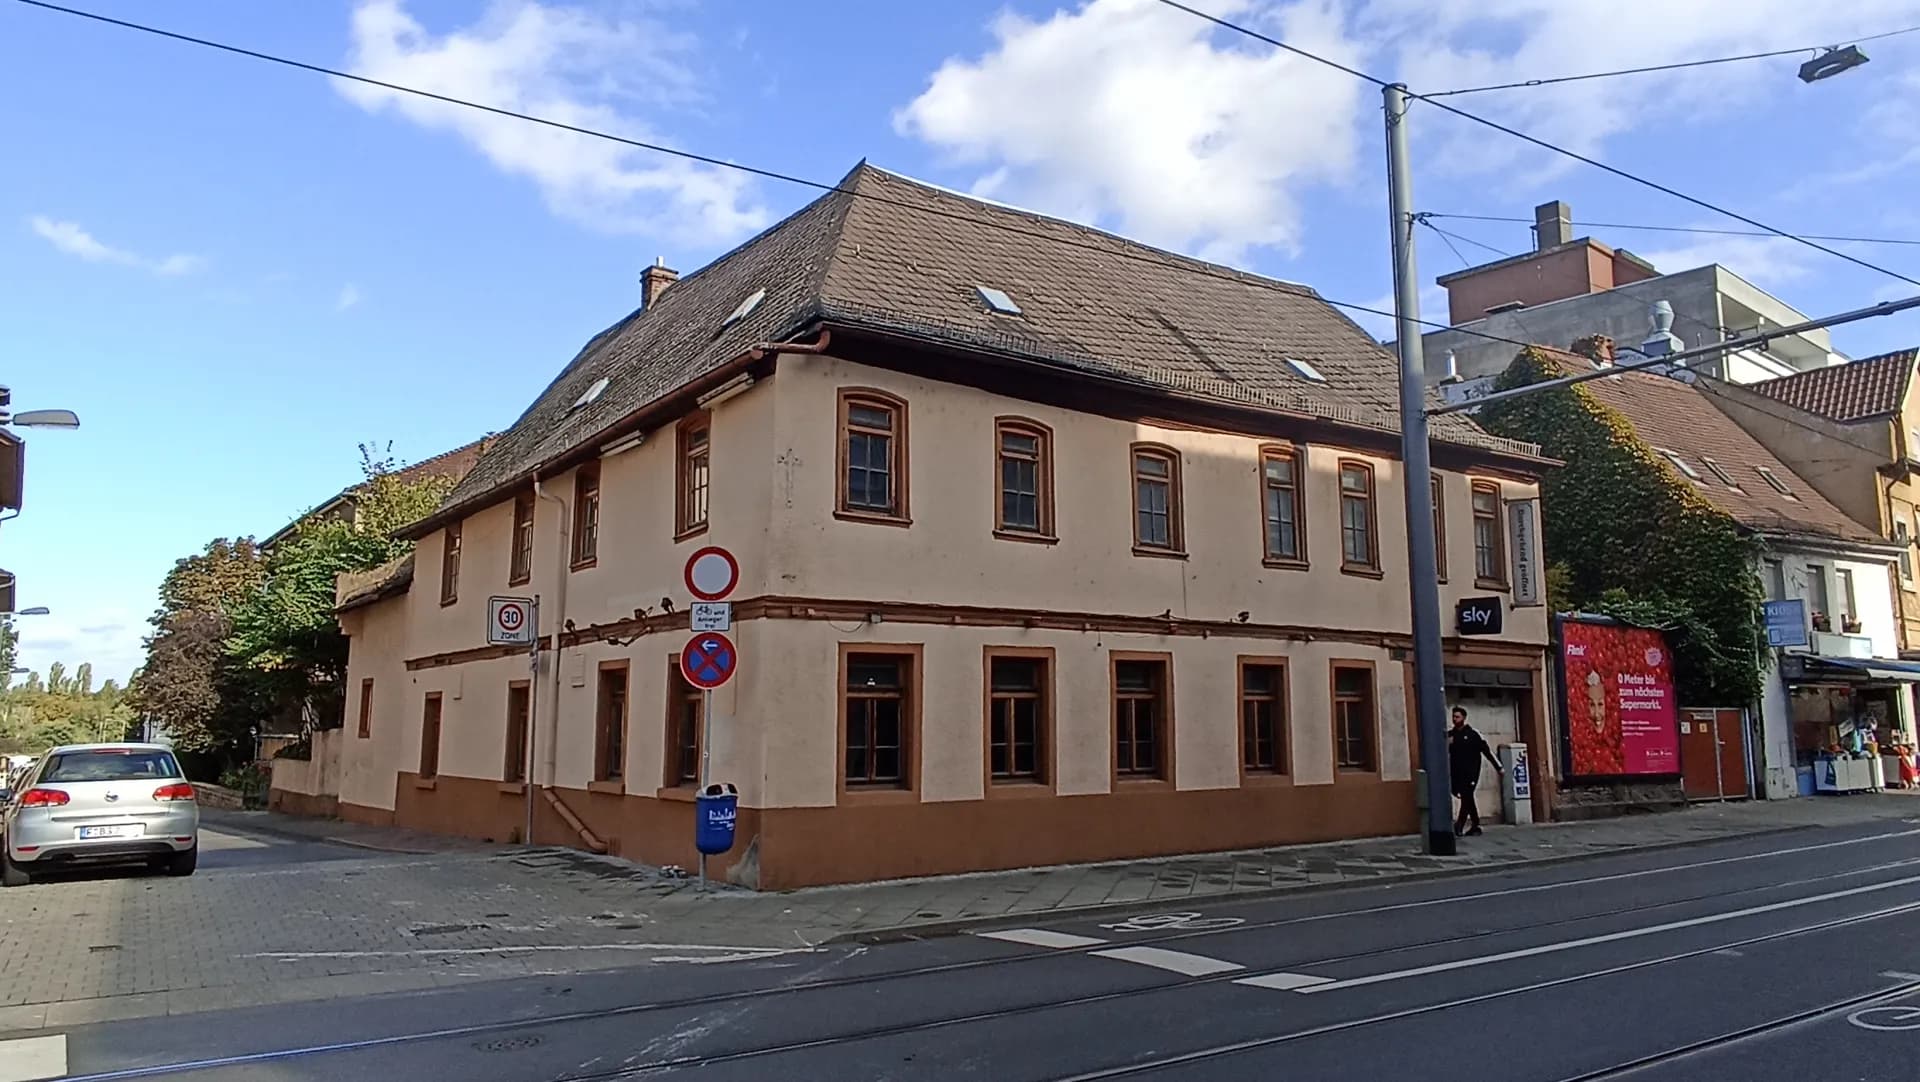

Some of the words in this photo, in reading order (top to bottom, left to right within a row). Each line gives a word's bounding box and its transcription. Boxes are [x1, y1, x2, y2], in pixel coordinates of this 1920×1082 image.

[503, 611, 519, 624] 30
[1462, 606, 1492, 626] sky
[1624, 674, 1643, 685] Meter
[1619, 688, 1634, 697] zum
[1634, 686, 1665, 697] nächsten
